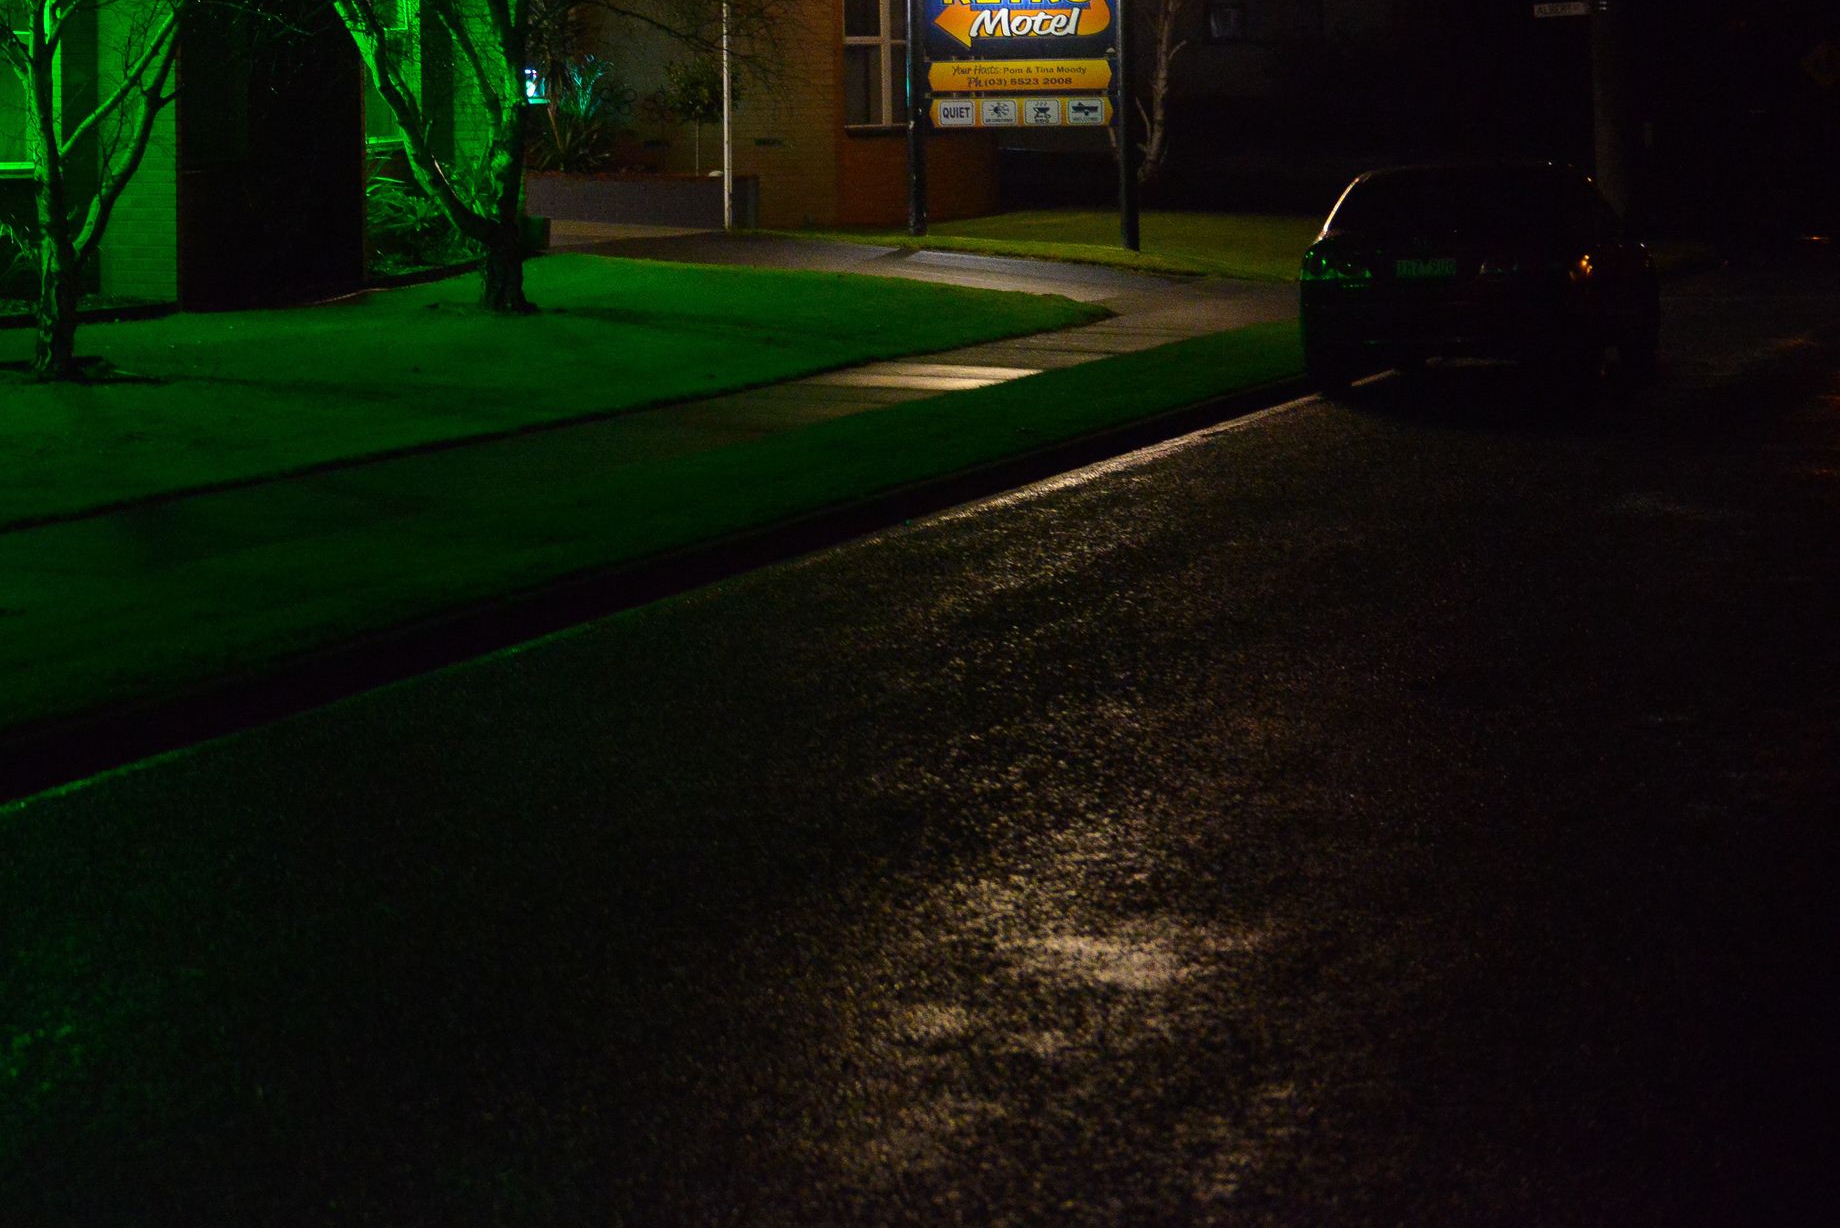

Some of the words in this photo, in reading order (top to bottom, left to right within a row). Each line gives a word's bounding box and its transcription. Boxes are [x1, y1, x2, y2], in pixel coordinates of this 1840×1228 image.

[969, 7, 1082, 37] Motel
[952, 65, 972, 76] Your
[1035, 66, 1054, 74] Tina
[1056, 66, 1087, 75] Moody
[1010, 77, 1039, 85] 5523
[1043, 77, 1073, 85] 2008
[942, 107, 971, 119] QUIET
